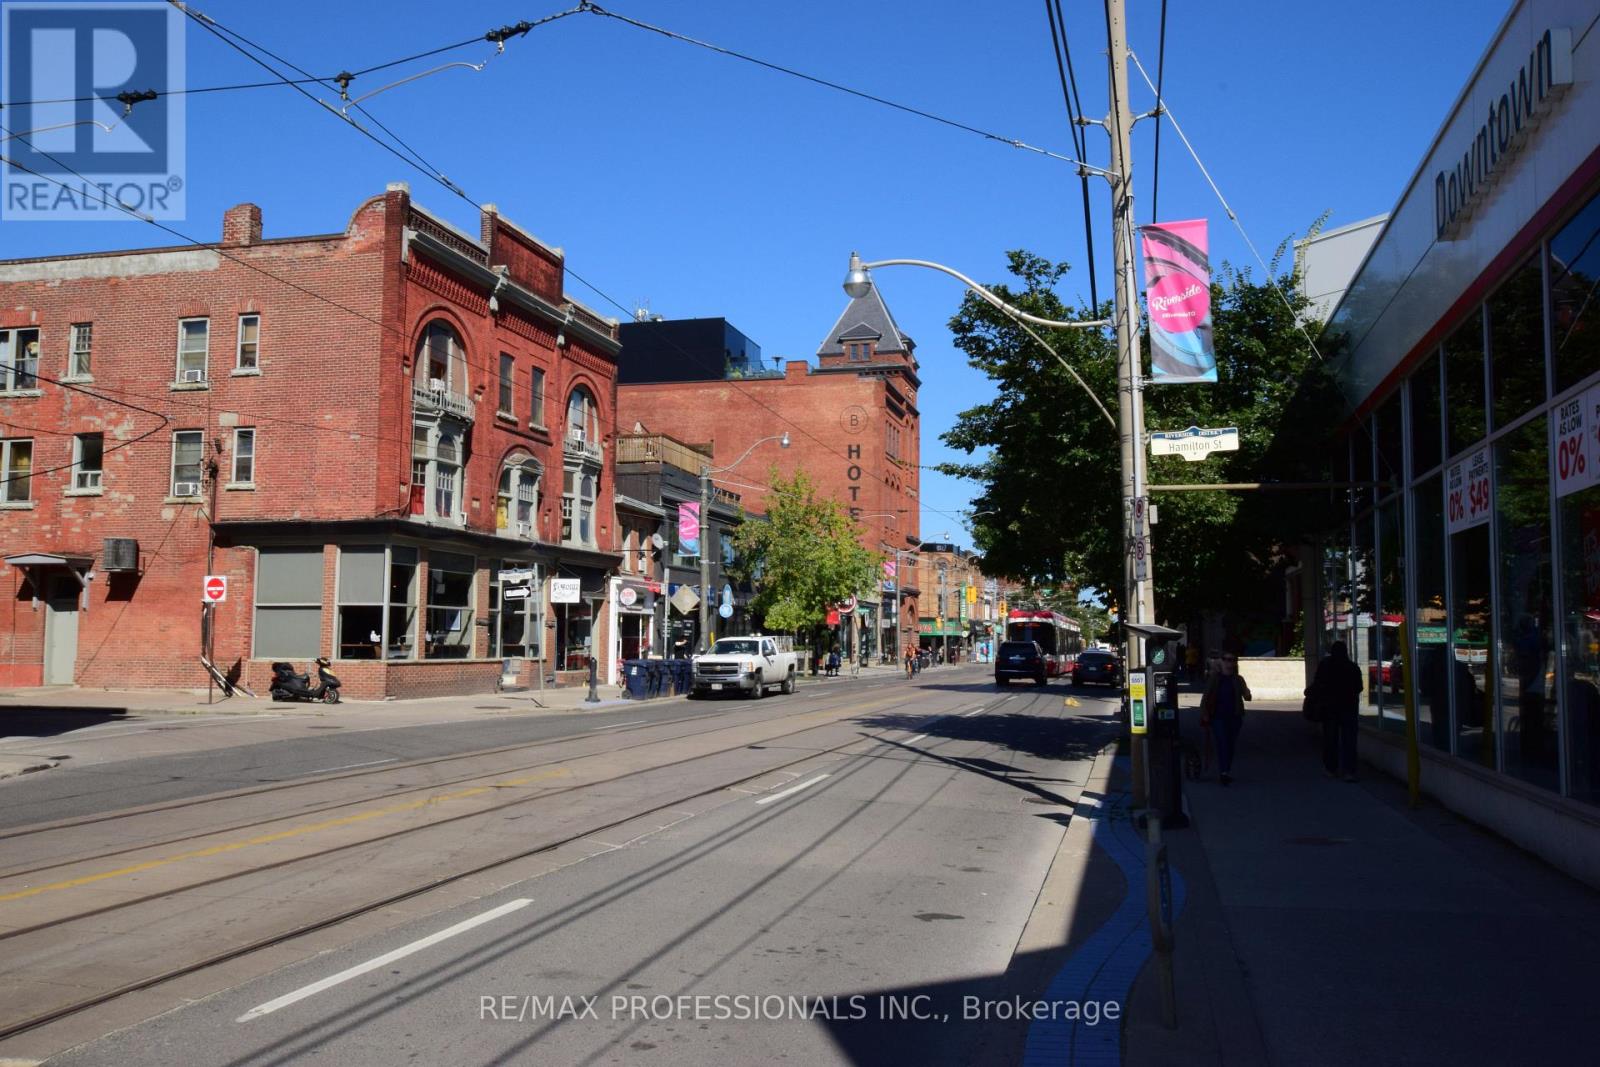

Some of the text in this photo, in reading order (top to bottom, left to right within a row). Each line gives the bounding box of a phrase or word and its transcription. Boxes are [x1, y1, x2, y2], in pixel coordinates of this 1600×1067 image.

[1435, 28, 1553, 243] Downtown
[1151, 284, 1202, 311] Riverside
[850, 414, 859, 427] B
[1560, 400, 1580, 419] RATES
[1559, 413, 1582, 435] AS LOW
[1168, 439, 1222, 453] Hamilton St
[1559, 433, 1585, 481] 0%
[847, 444, 862, 523] HOTE
[1449, 489, 1464, 523] 0%
